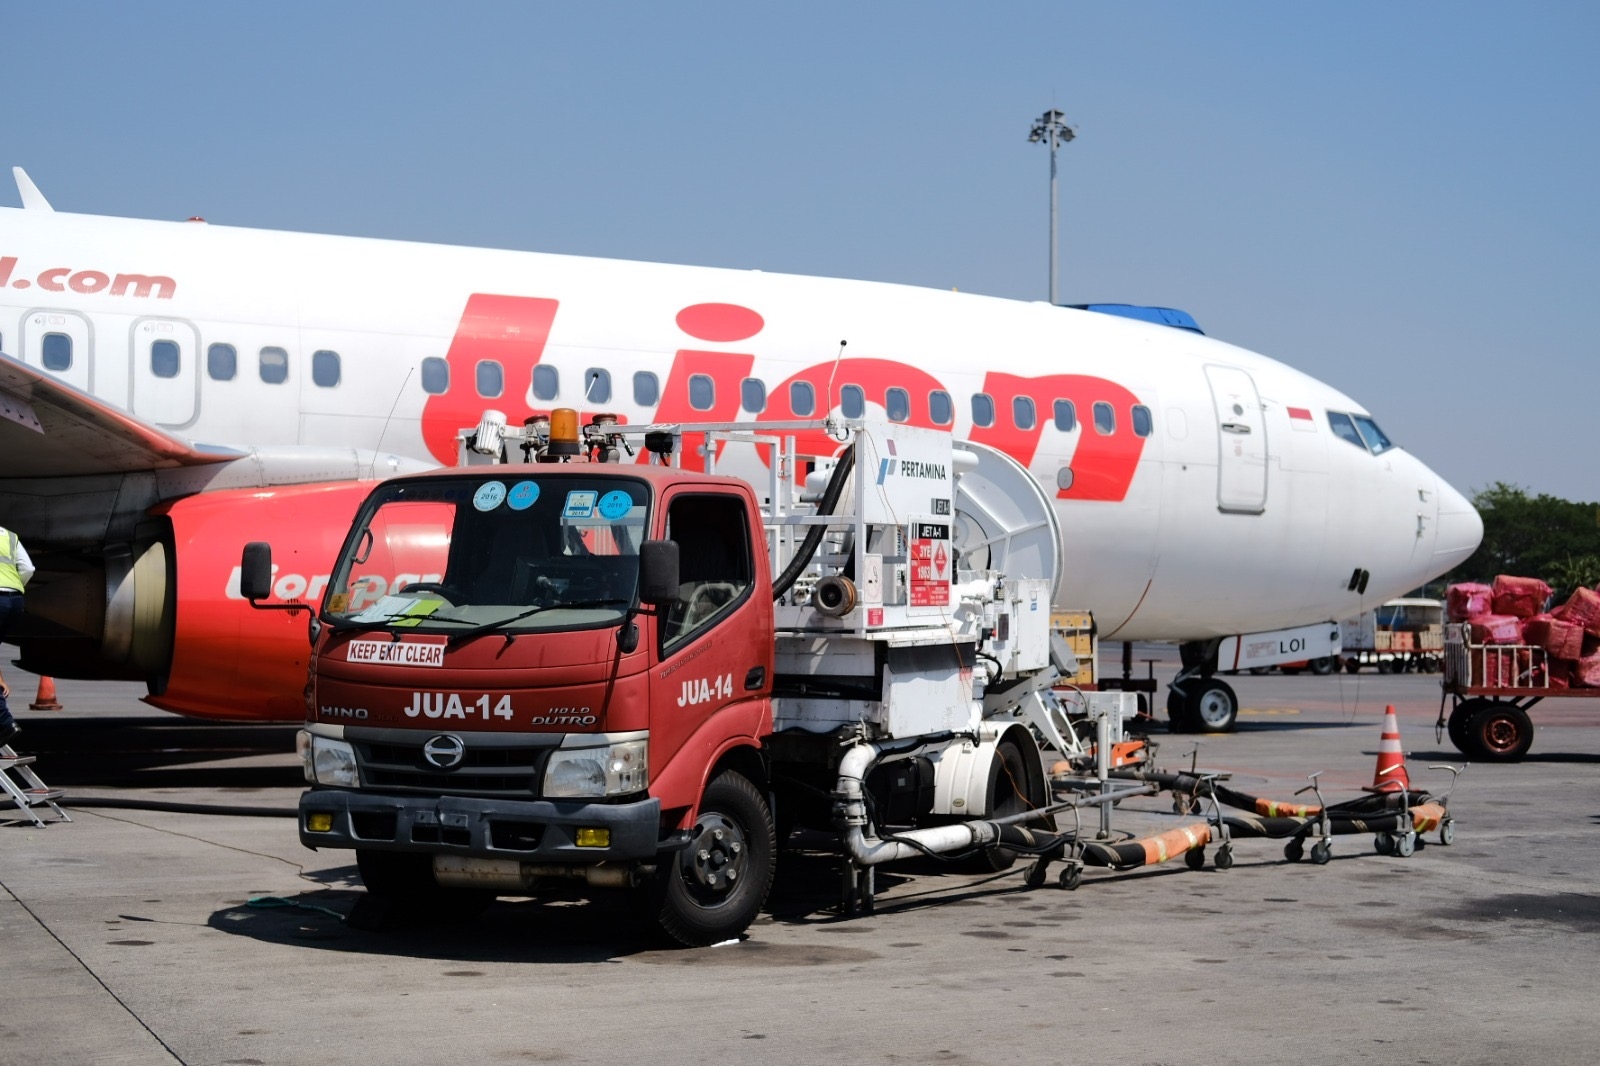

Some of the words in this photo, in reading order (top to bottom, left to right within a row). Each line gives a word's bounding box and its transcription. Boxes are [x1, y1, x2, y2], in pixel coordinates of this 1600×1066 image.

[901, 460, 947, 480] PERTAMINA
[922, 526, 933, 538] JET
[933, 526, 942, 538] A-1
[349, 643, 377, 660] KEEP
[379, 643, 404, 662] EXIT
[405, 645, 442, 664] CLEAR
[1280, 637, 1305, 654] LOI
[677, 672, 733, 708] JUA-14
[321, 705, 369, 720] HINO
[404, 692, 514, 720] JUA-14
[531, 715, 597, 726] DUTRO
